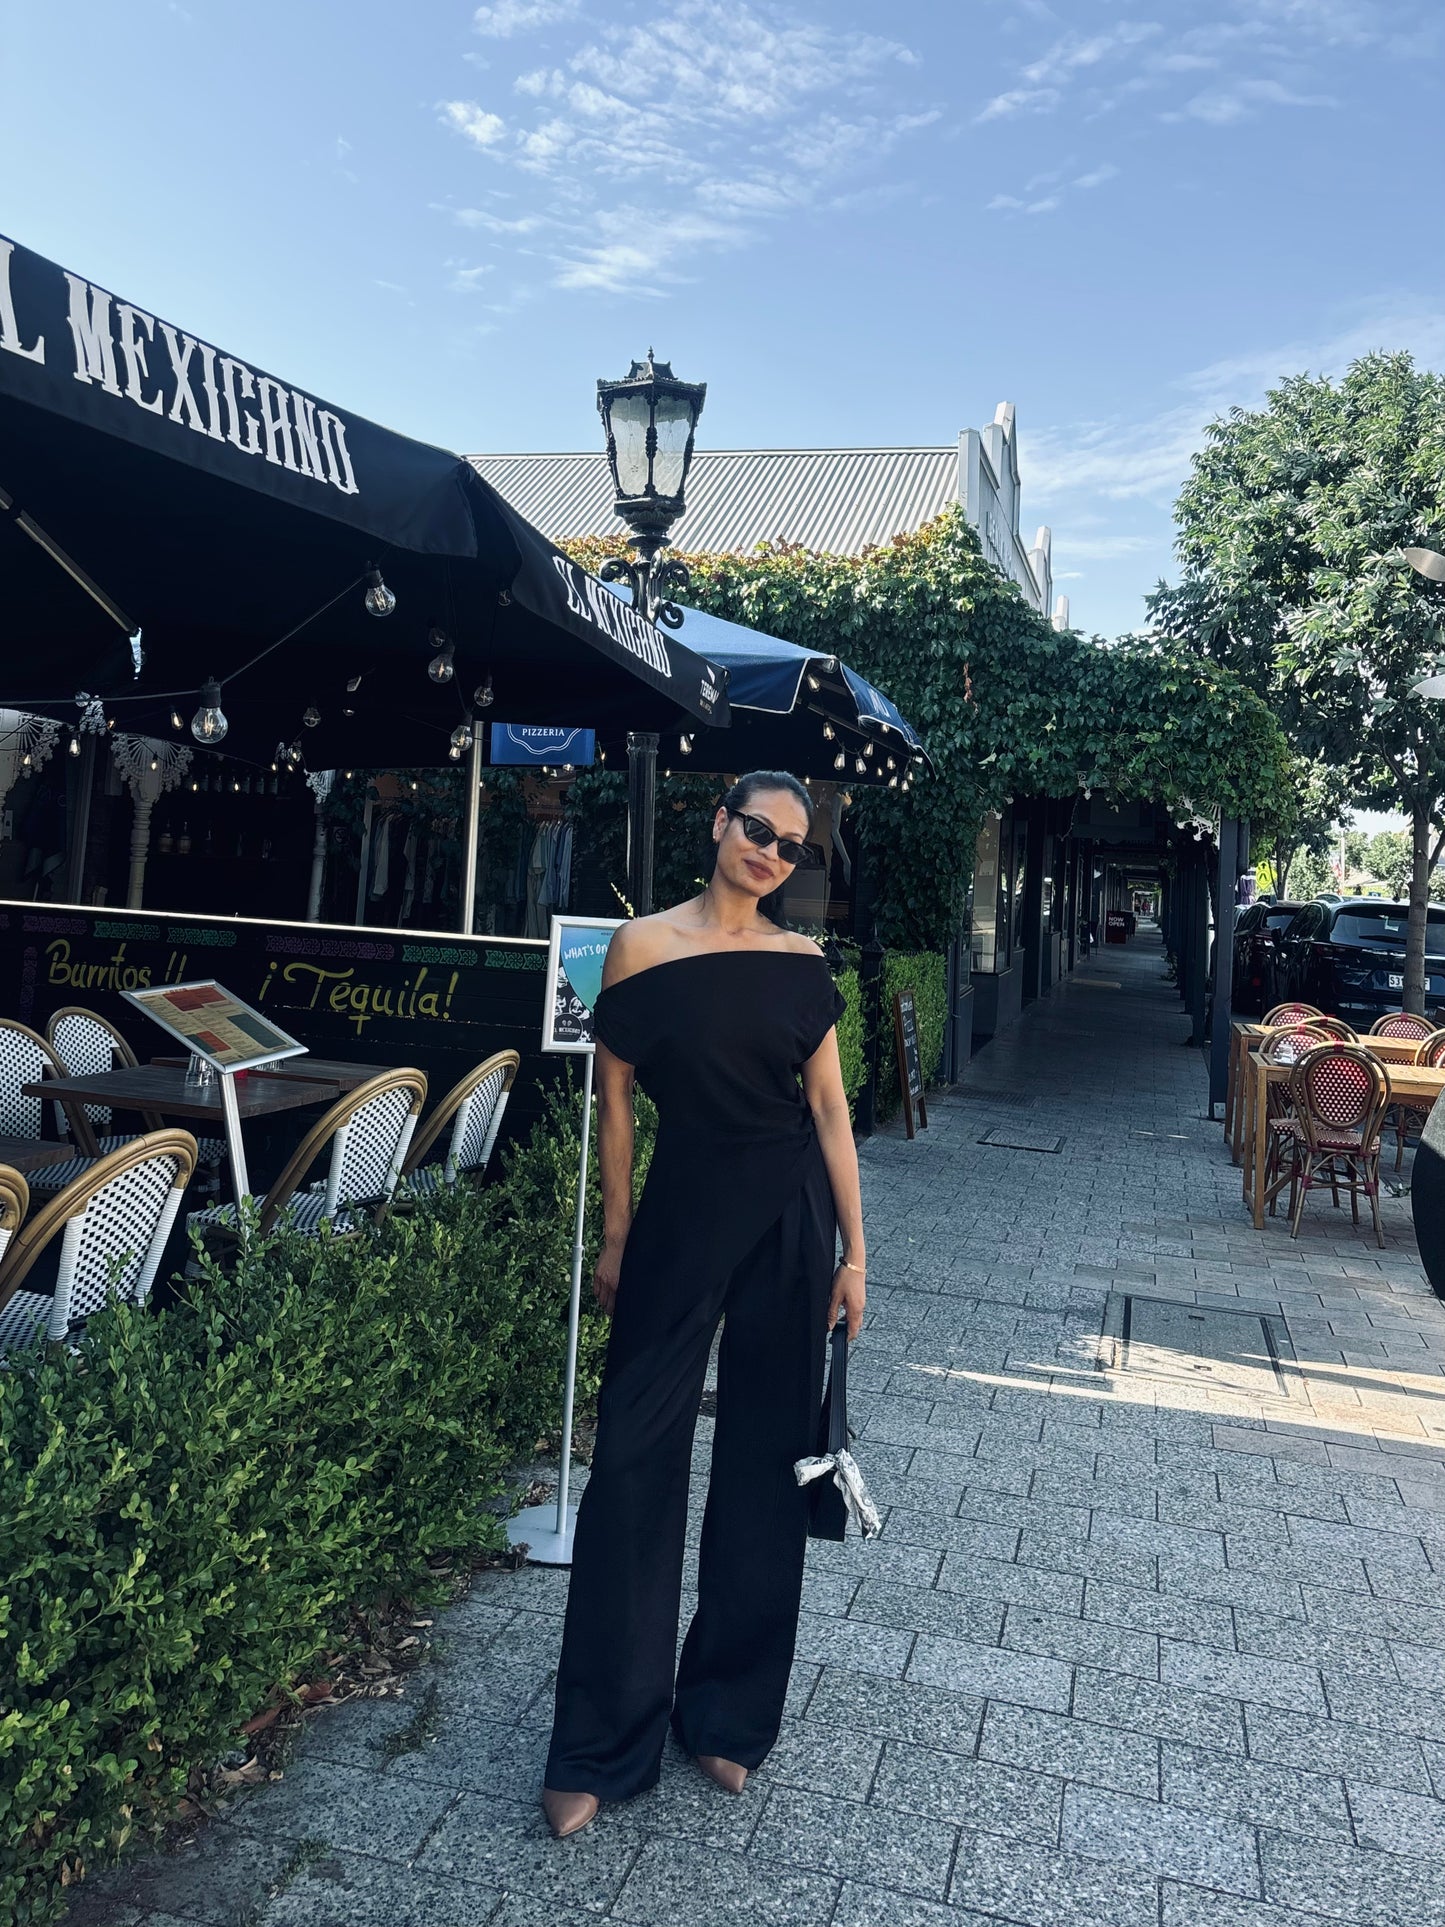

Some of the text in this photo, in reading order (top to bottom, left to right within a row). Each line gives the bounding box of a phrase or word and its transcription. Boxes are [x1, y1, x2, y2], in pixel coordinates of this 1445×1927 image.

[63, 272, 360, 496] MEXICANO
[552, 555, 673, 678] EL MEXICANO
[521, 728, 566, 737] PIZZERIA
[44, 938, 152, 990] Burritos
[564, 943, 595, 960] WHAT'S
